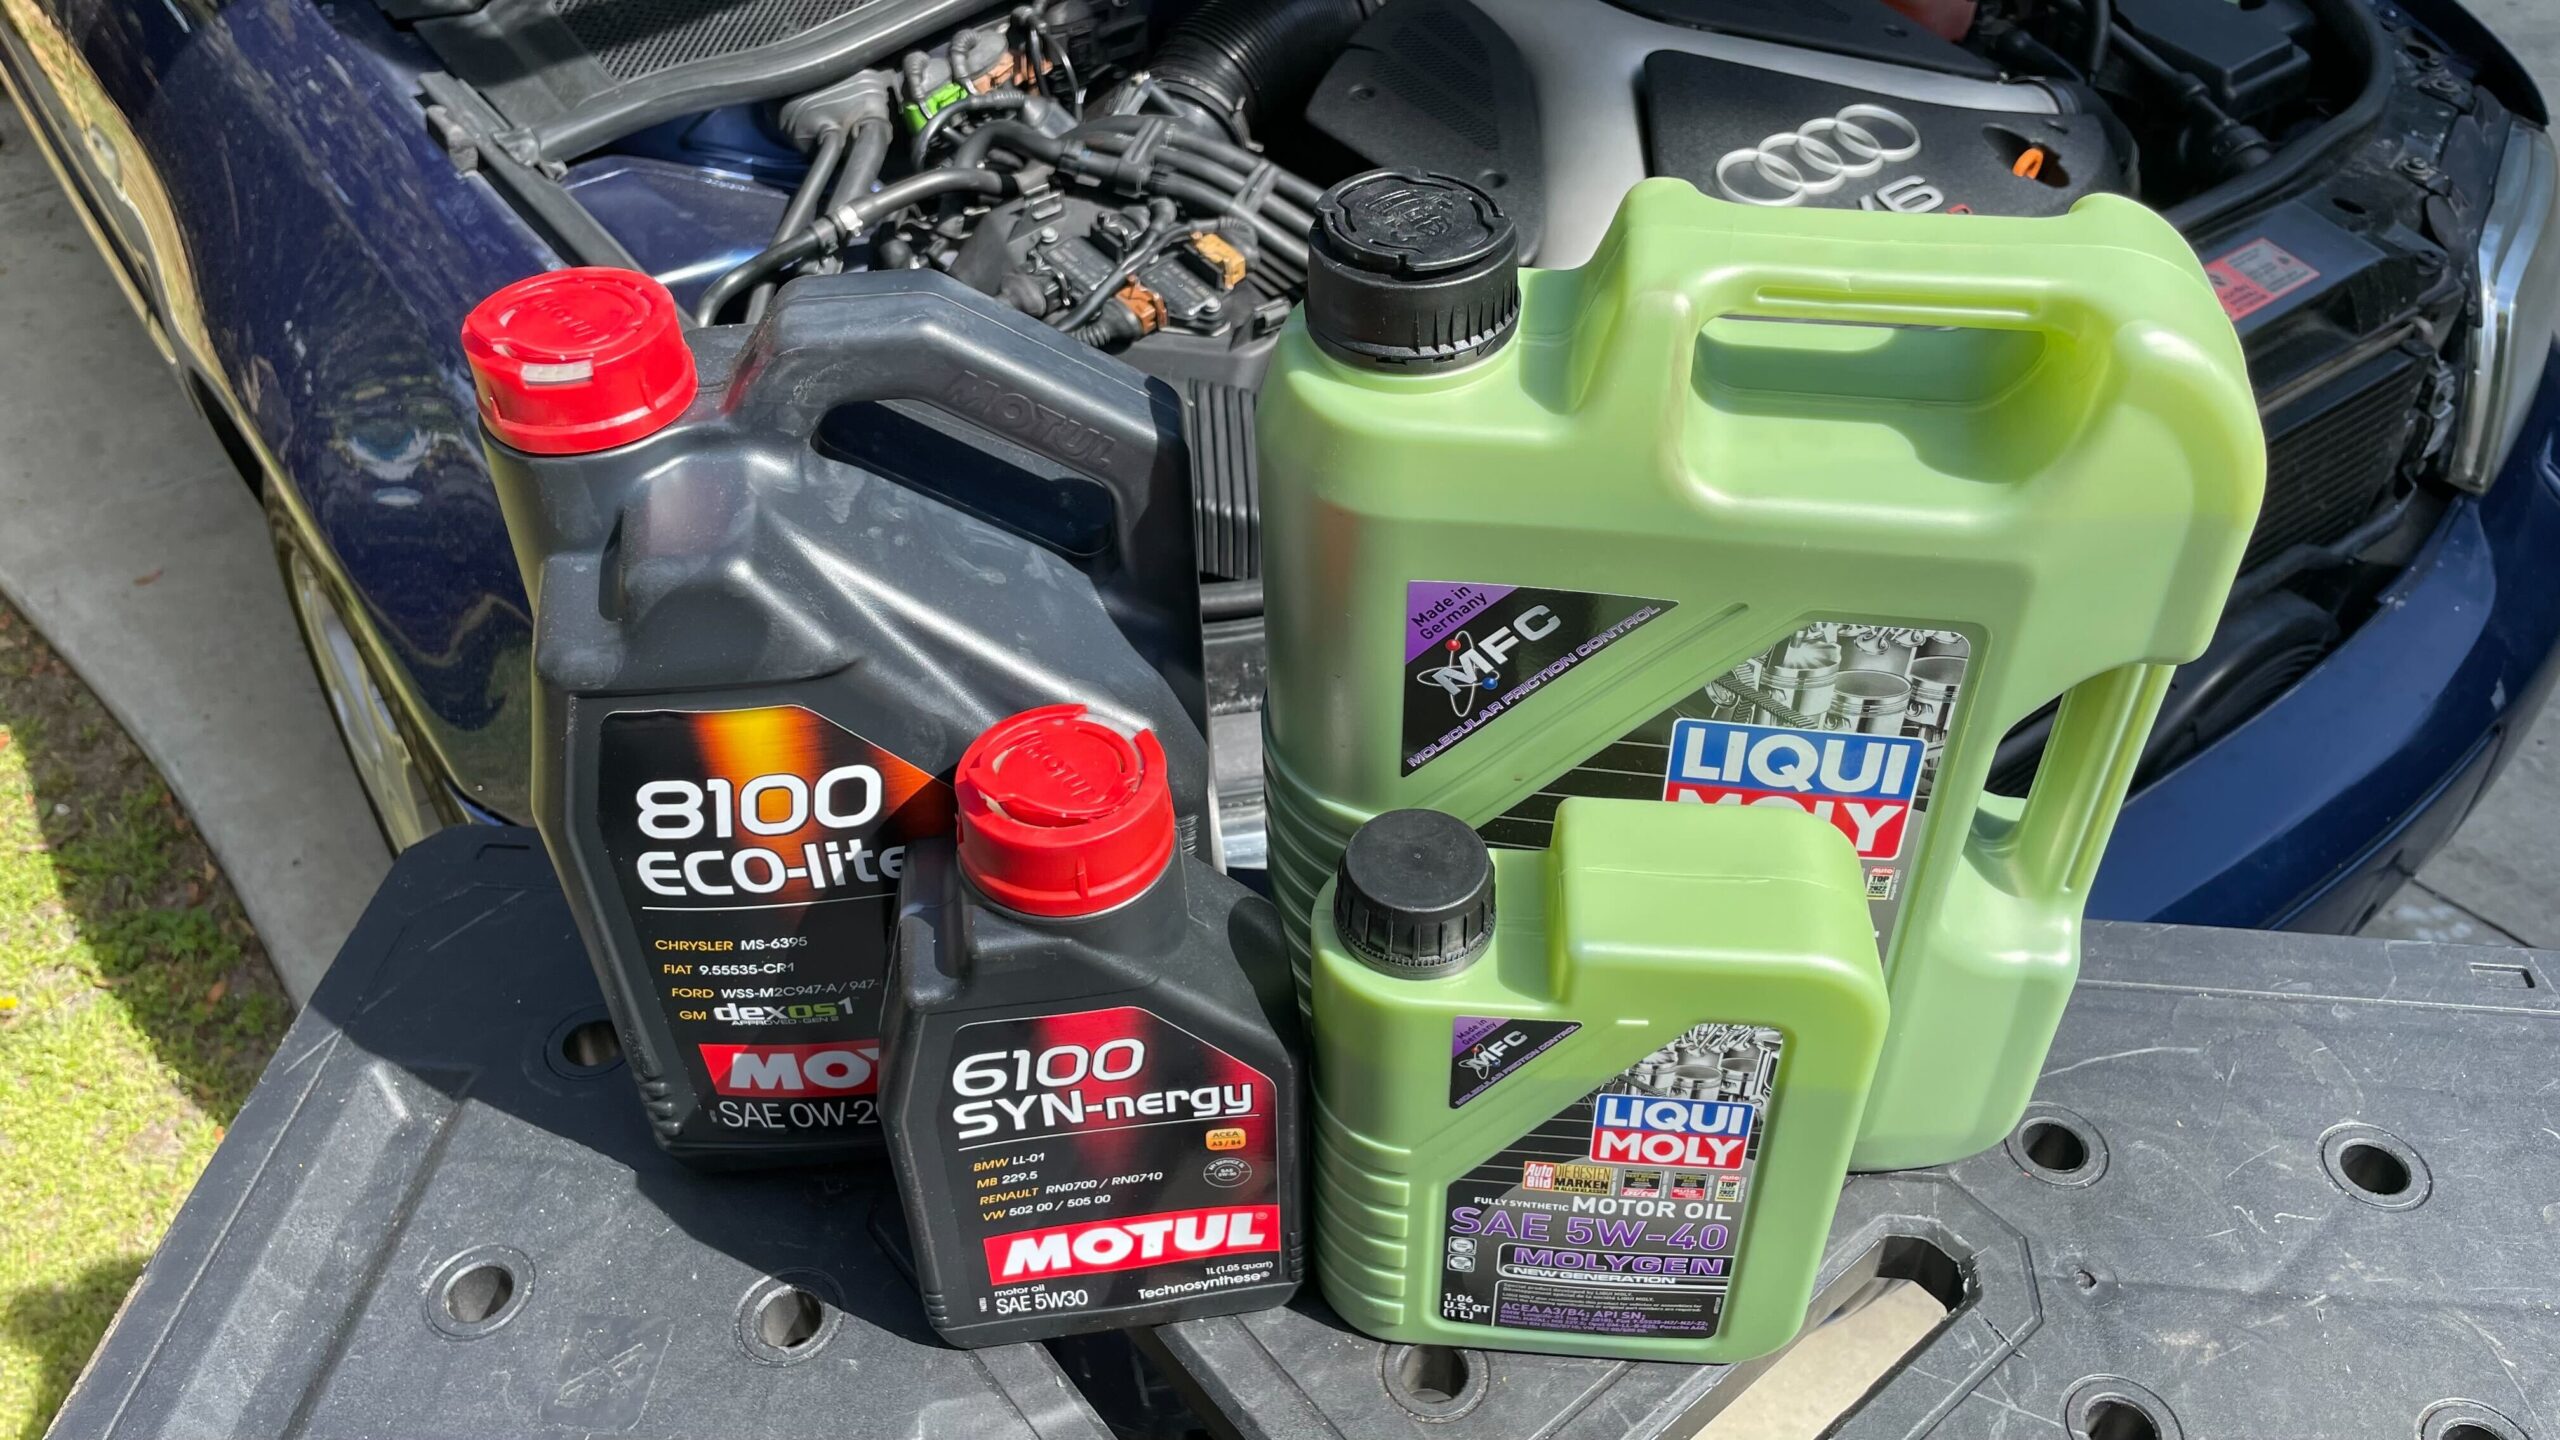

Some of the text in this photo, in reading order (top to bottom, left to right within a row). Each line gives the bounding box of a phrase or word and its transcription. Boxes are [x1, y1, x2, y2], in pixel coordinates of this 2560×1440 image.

[946, 370, 1116, 468] MOTUL
[1411, 584, 1472, 628] Made in
[1419, 591, 1488, 640] Germany
[1432, 604, 1561, 696] MFC
[1407, 605, 1661, 768] MOLECULAR FRICTION CONTROL
[1682, 727, 1911, 795] LIQUI
[636, 764, 882, 840] 8100
[655, 936, 808, 952] CHRYSLER MS-6395
[664, 962, 794, 976] FIAT 9.55535-CR1
[672, 988, 714, 998] FORD
[679, 1010, 706, 1020] GM
[1456, 1018, 1488, 1040] Made in
[1462, 1022, 1497, 1046] Germany
[1466, 1030, 1528, 1071] MFC
[952, 1038, 1145, 1097] 6100
[719, 1101, 786, 1128] SAE
[789, 1100, 880, 1128] 0W-2
[952, 1082, 1252, 1140] SYN-nergy
[1602, 1098, 1746, 1135] LIQUI
[1213, 1130, 1239, 1138] ACEA
[1598, 1130, 1743, 1166] MOLY
[973, 1152, 1046, 1172] BMW LL-01
[1525, 1163, 1554, 1178] Auto
[1556, 1164, 1570, 1178] DIE
[1573, 1165, 1611, 1180] BESTEN
[976, 1170, 1038, 1189] MB 229.5
[979, 1171, 1164, 1206] RENAULT RN0700 / RN0710
[1526, 1176, 1552, 1189] Bild
[1554, 1178, 1608, 1190] MARKEN
[982, 1194, 1112, 1221] VW 502 00 / 505 00
[1474, 1196, 1732, 1220] FULLY SYNTHETIC MOTOR OIL
[1450, 1206, 1728, 1250] SAE 5W-40
[1002, 1213, 1265, 1276] MOTUL
[1241, 1260, 1274, 1271] quart)
[1514, 1247, 1724, 1276] MOLYGEN
[1513, 1266, 1676, 1284] NEW GENERATION
[994, 1284, 1046, 1297] motor oil
[996, 1295, 1032, 1314] SAE
[1035, 1289, 1088, 1310] 5W30
[1444, 1292, 1474, 1303] 1.06
[1444, 1308, 1474, 1320] (1 L)
[1472, 1304, 1490, 1313] QT
[1501, 1302, 1539, 1312] ACEA
[1542, 1306, 1590, 1318] A3/B4;
[1592, 1310, 1618, 1318] API
